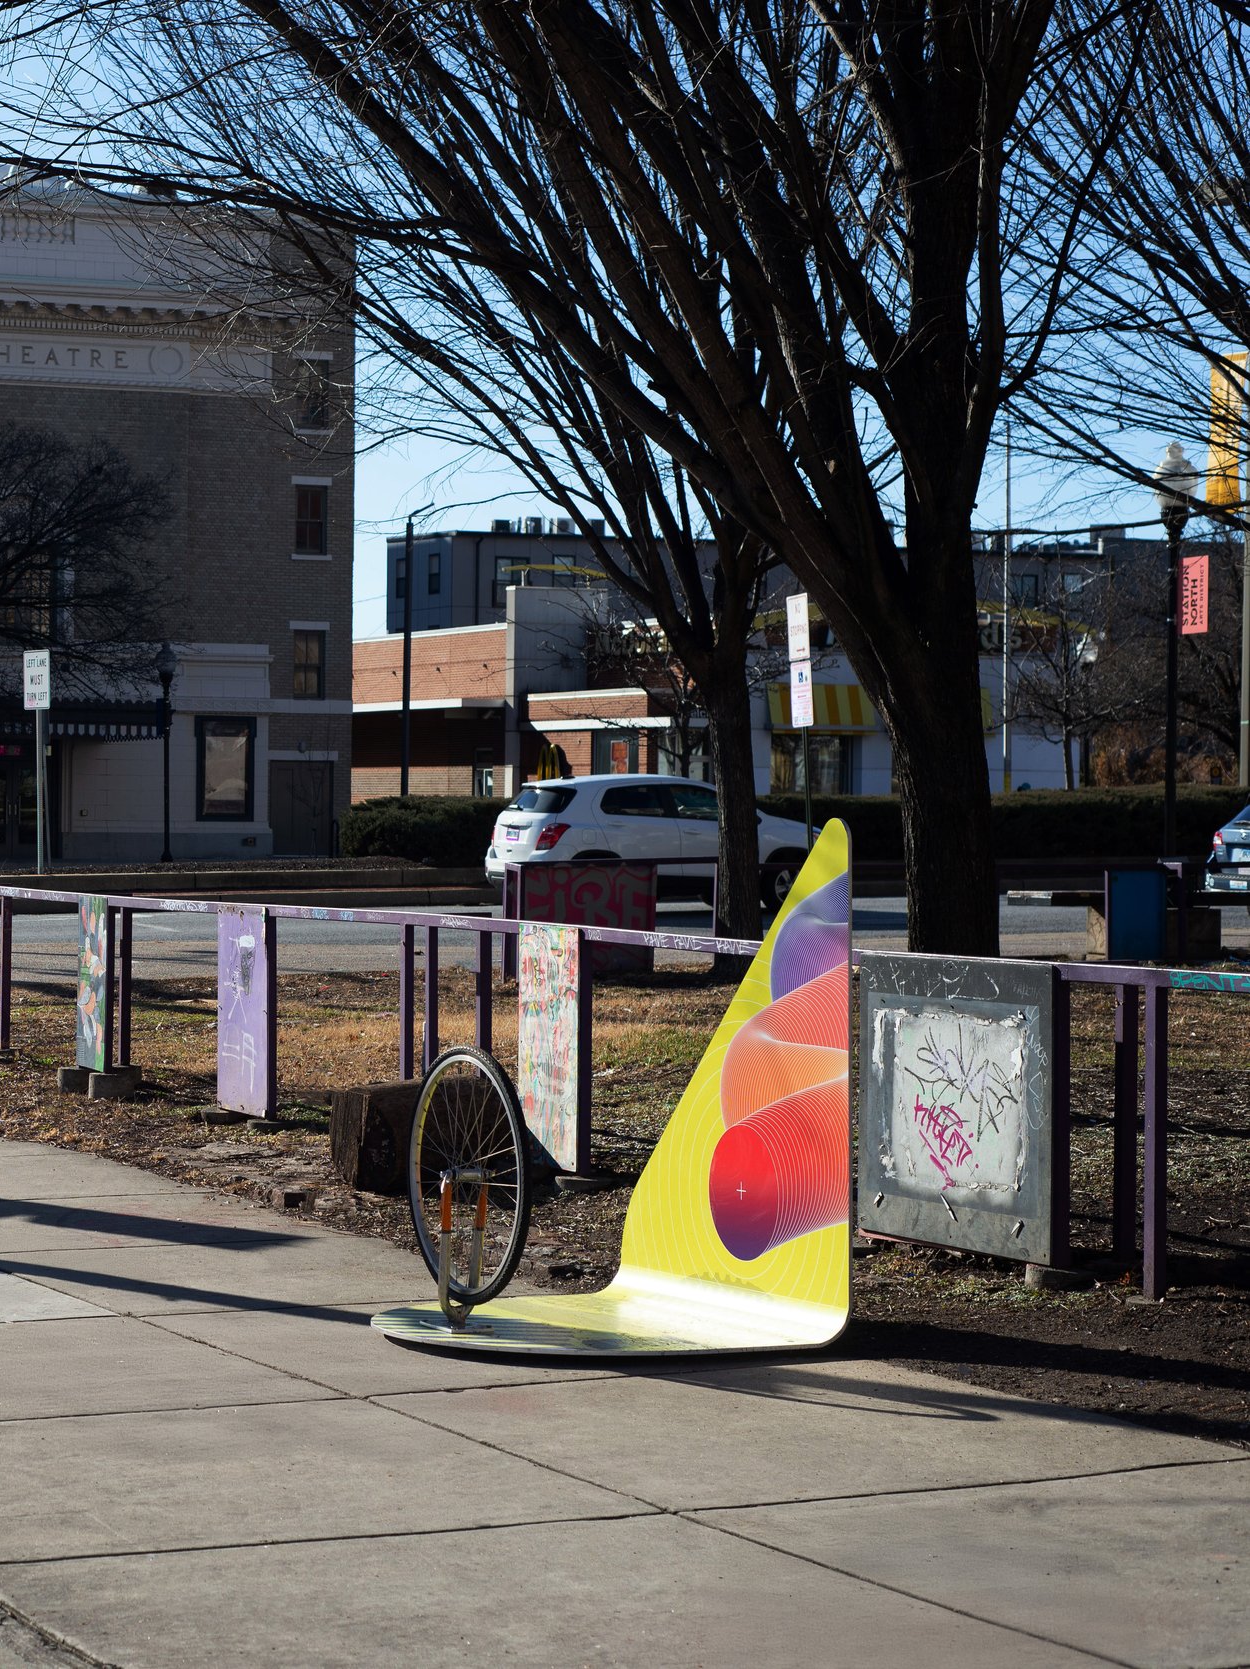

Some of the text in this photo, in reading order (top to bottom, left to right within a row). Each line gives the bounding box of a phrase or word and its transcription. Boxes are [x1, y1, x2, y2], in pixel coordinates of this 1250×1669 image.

[1182, 564, 1190, 626] STATION
[1190, 578, 1198, 626] NORTH
[26, 657, 47, 668] LEFT LANE
[30, 674, 43, 686] MUST
[26, 691, 48, 702] TURN LEFT
